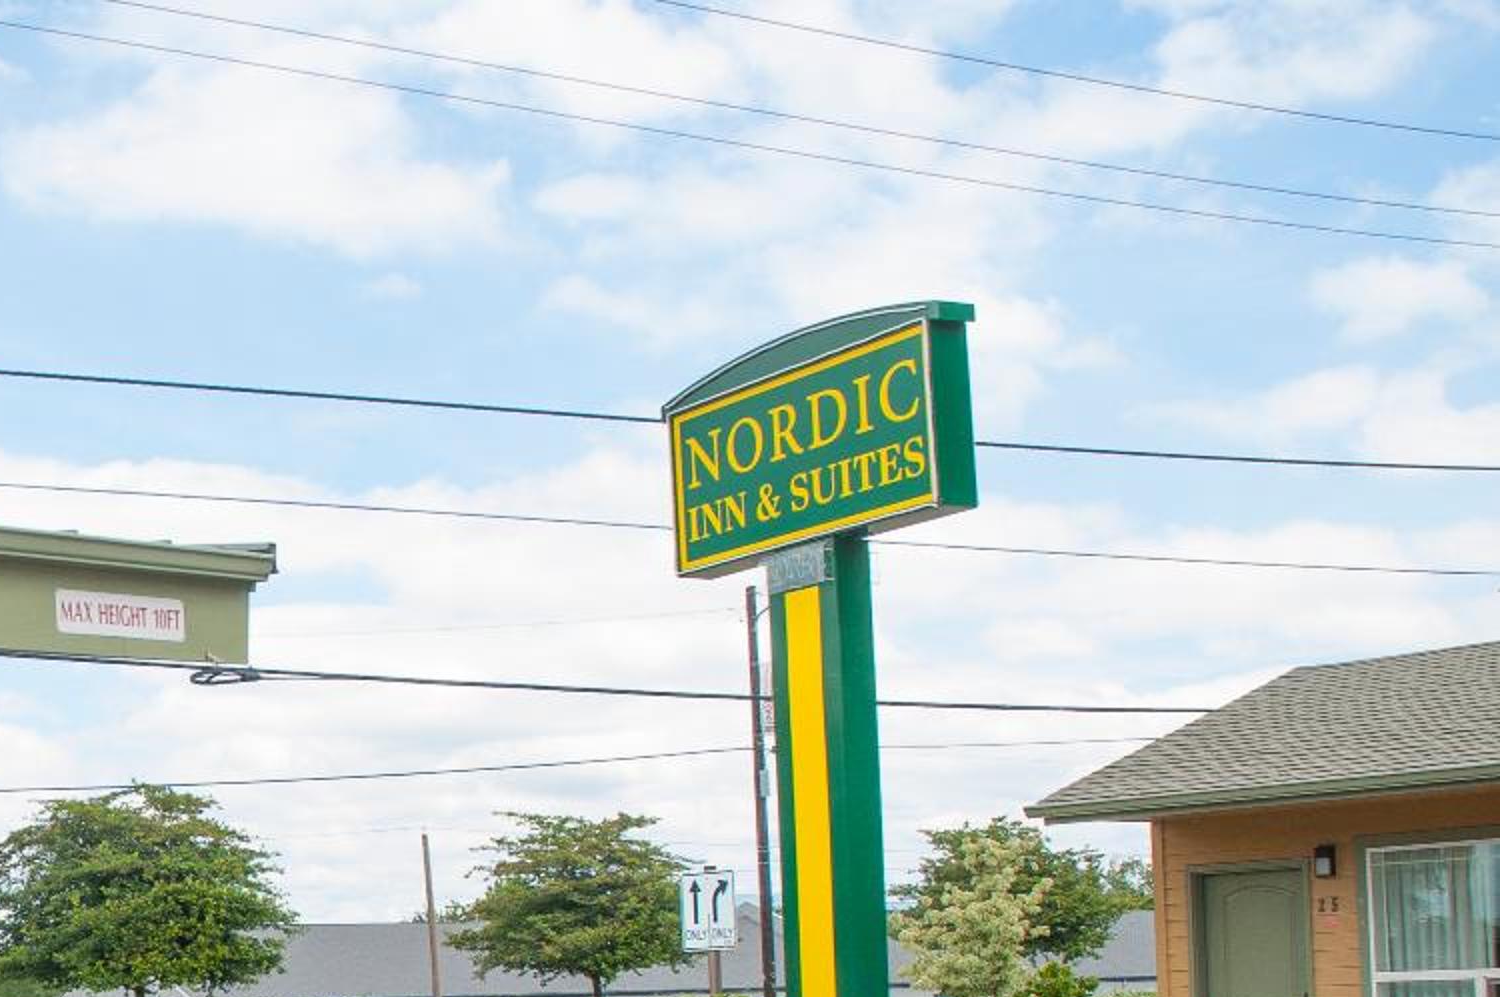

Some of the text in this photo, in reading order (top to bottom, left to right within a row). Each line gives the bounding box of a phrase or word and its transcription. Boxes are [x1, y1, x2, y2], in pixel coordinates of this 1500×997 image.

[685, 359, 920, 490] NORDIC
[687, 435, 926, 543] INN & SUITES
[61, 600, 181, 631] MAX HEIGHT 10FT
[685, 929, 707, 941] ONLY
[709, 927, 733, 940] ONLY
